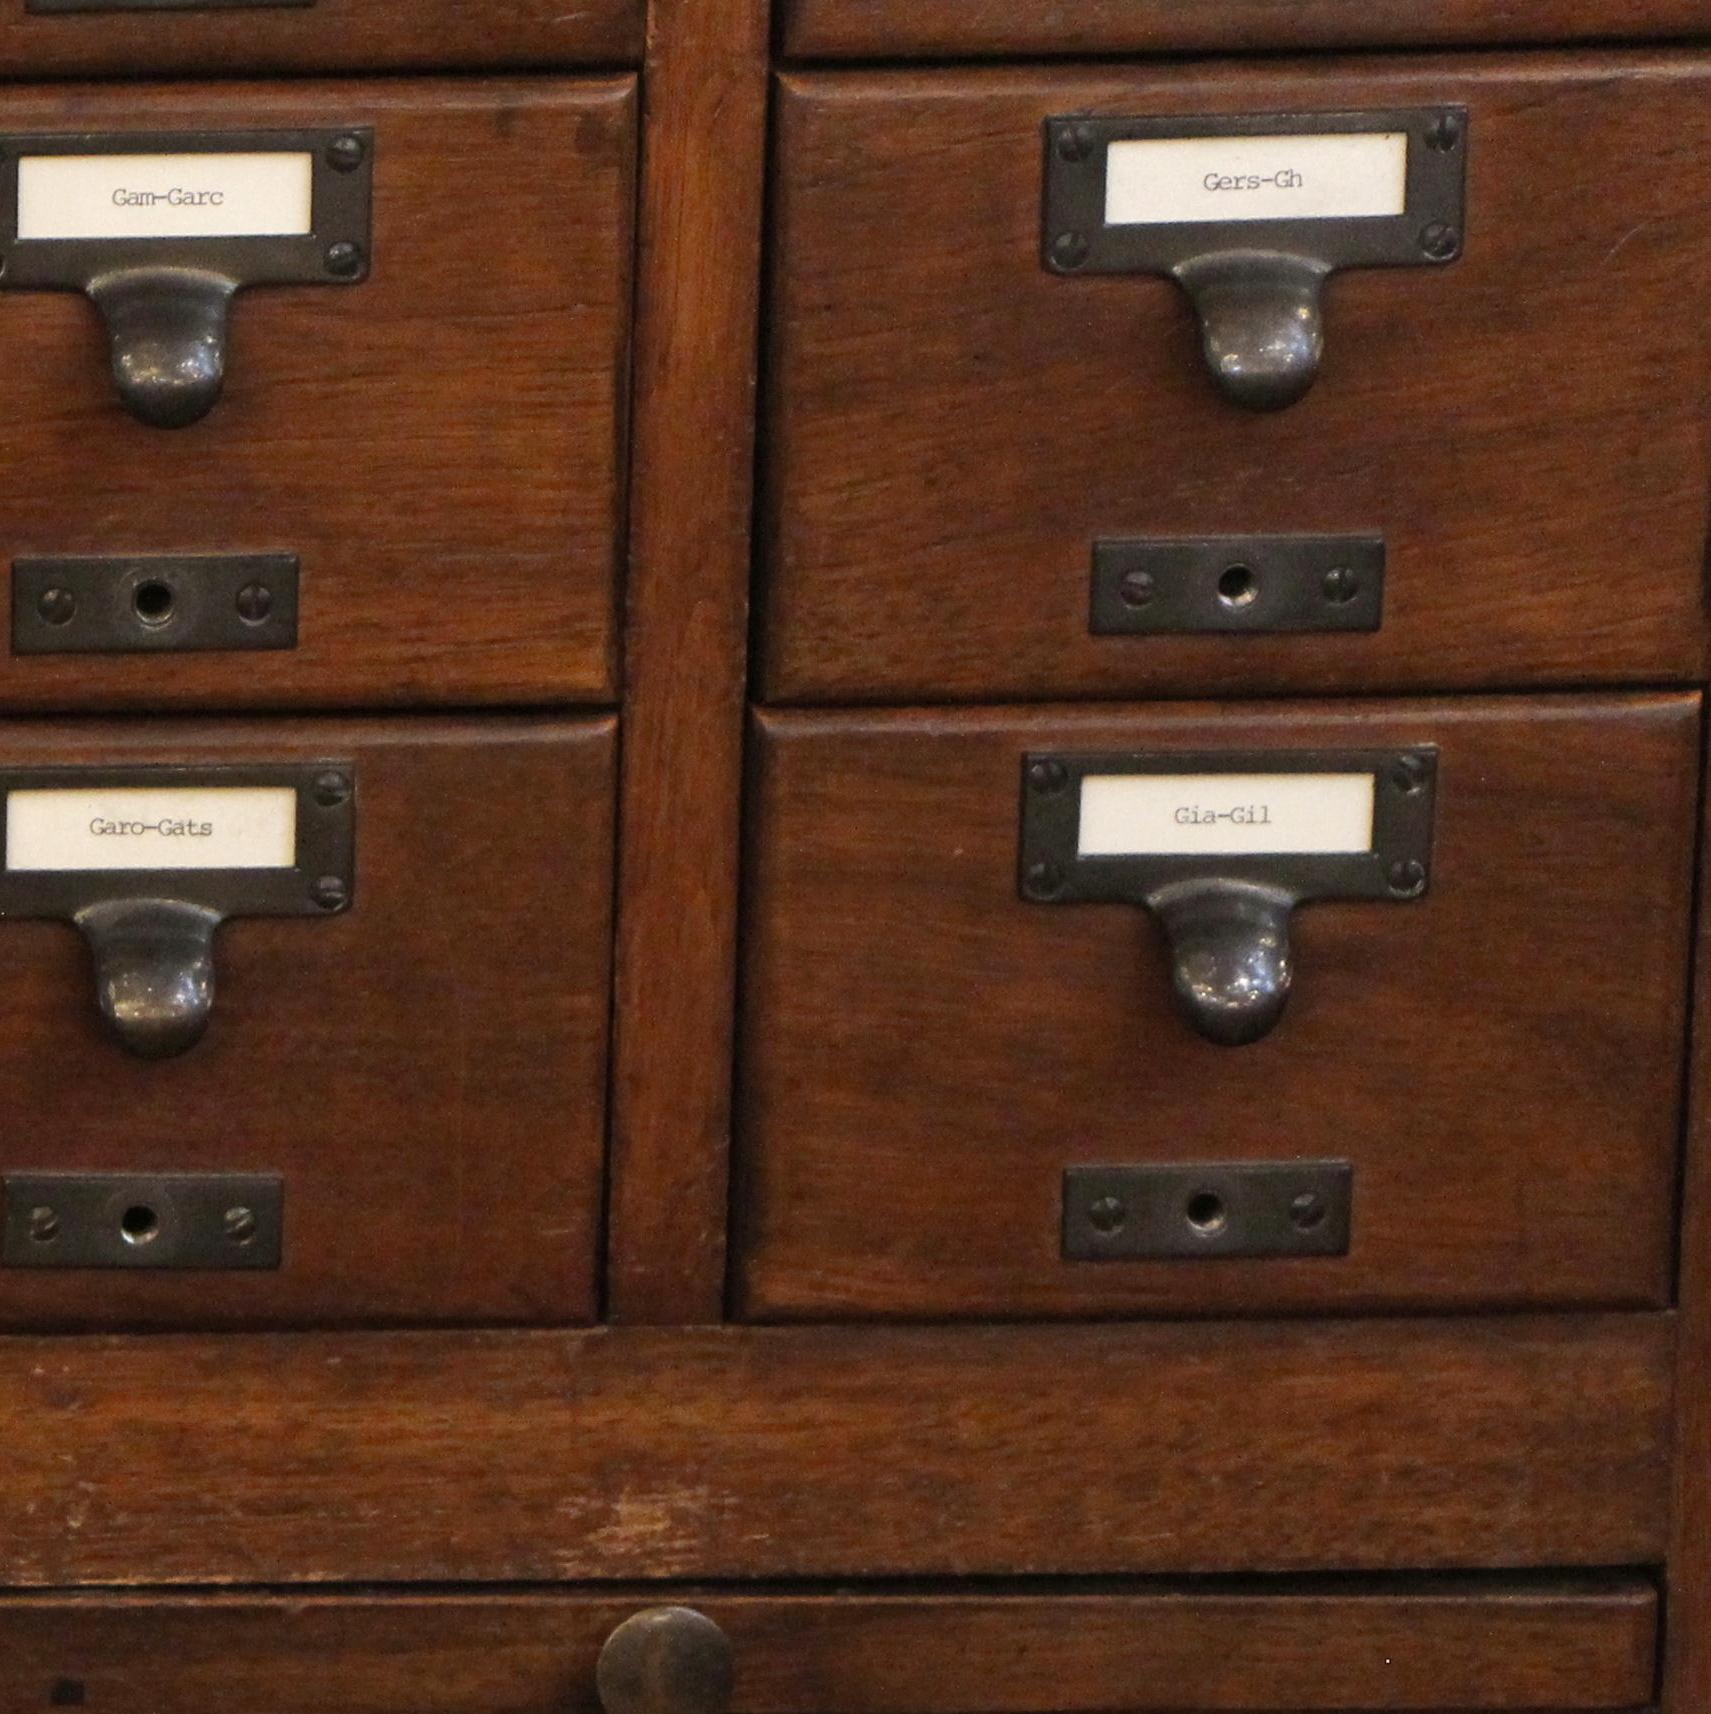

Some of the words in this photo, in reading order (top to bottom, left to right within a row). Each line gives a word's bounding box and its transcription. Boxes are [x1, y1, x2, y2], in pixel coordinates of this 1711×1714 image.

[1202, 169, 1304, 193] Gers-Gh
[111, 187, 225, 207] Gam-Garc
[1173, 804, 1272, 825] Gia-Gil
[88, 817, 213, 838] Garo-Gats
